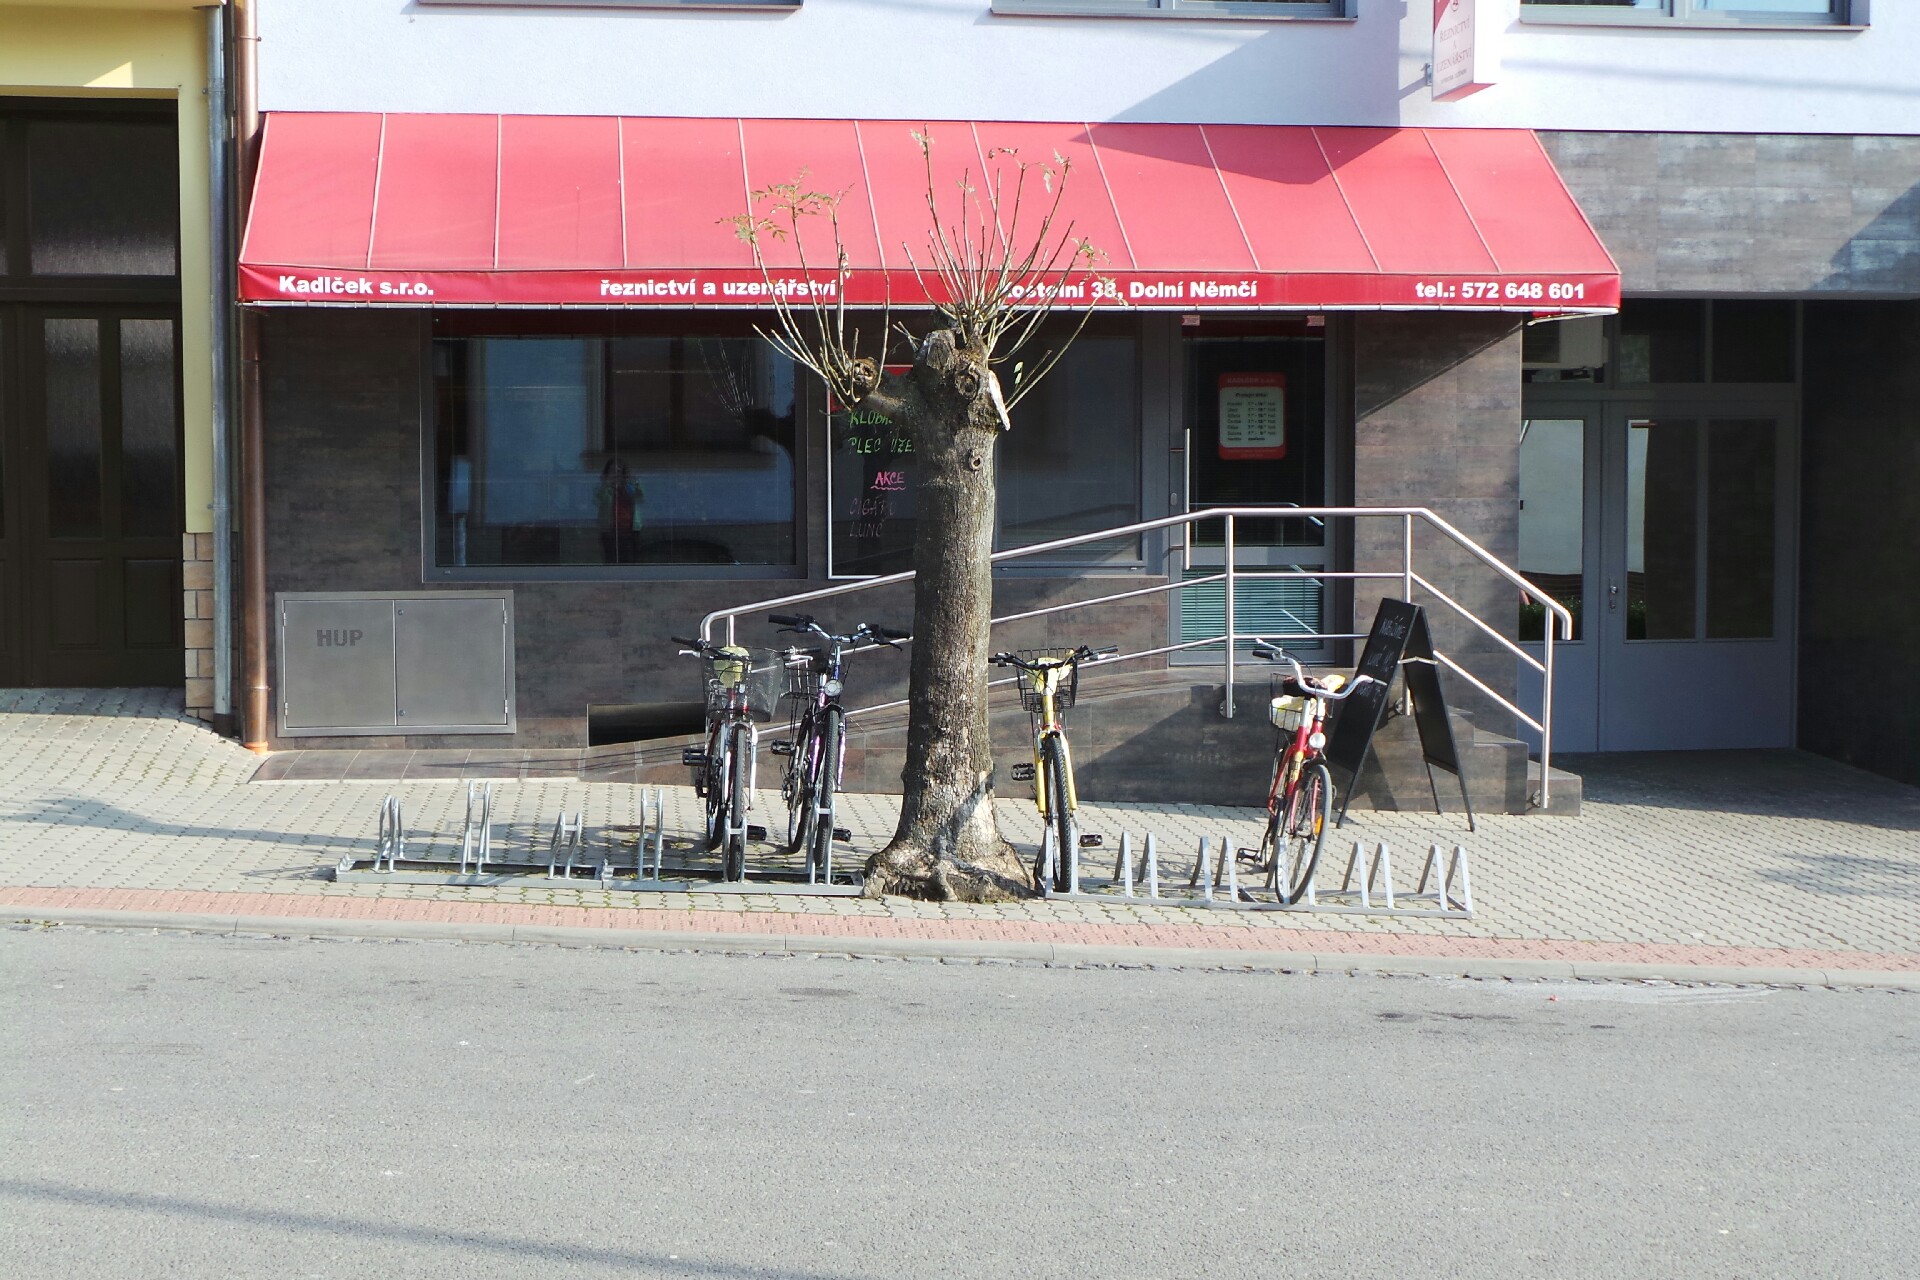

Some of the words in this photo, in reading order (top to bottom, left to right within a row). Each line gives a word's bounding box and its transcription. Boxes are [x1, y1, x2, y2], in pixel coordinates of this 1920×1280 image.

[279, 275, 373, 294] Kadlček
[379, 281, 434, 295] s.r.o.
[600, 279, 696, 296] řeznictví
[702, 282, 716, 295] a
[722, 279, 836, 296] uzenářství
[1091, 281, 1124, 299] 38,
[1130, 281, 1183, 298] Dolní
[1190, 281, 1257, 298] Němčí
[1415, 282, 1455, 298] tel.:
[1461, 282, 1499, 299] 572
[1505, 283, 1543, 299] 648
[1548, 283, 1584, 299] 601
[874, 471, 905, 485] AKCE
[316, 629, 363, 647] HUP
